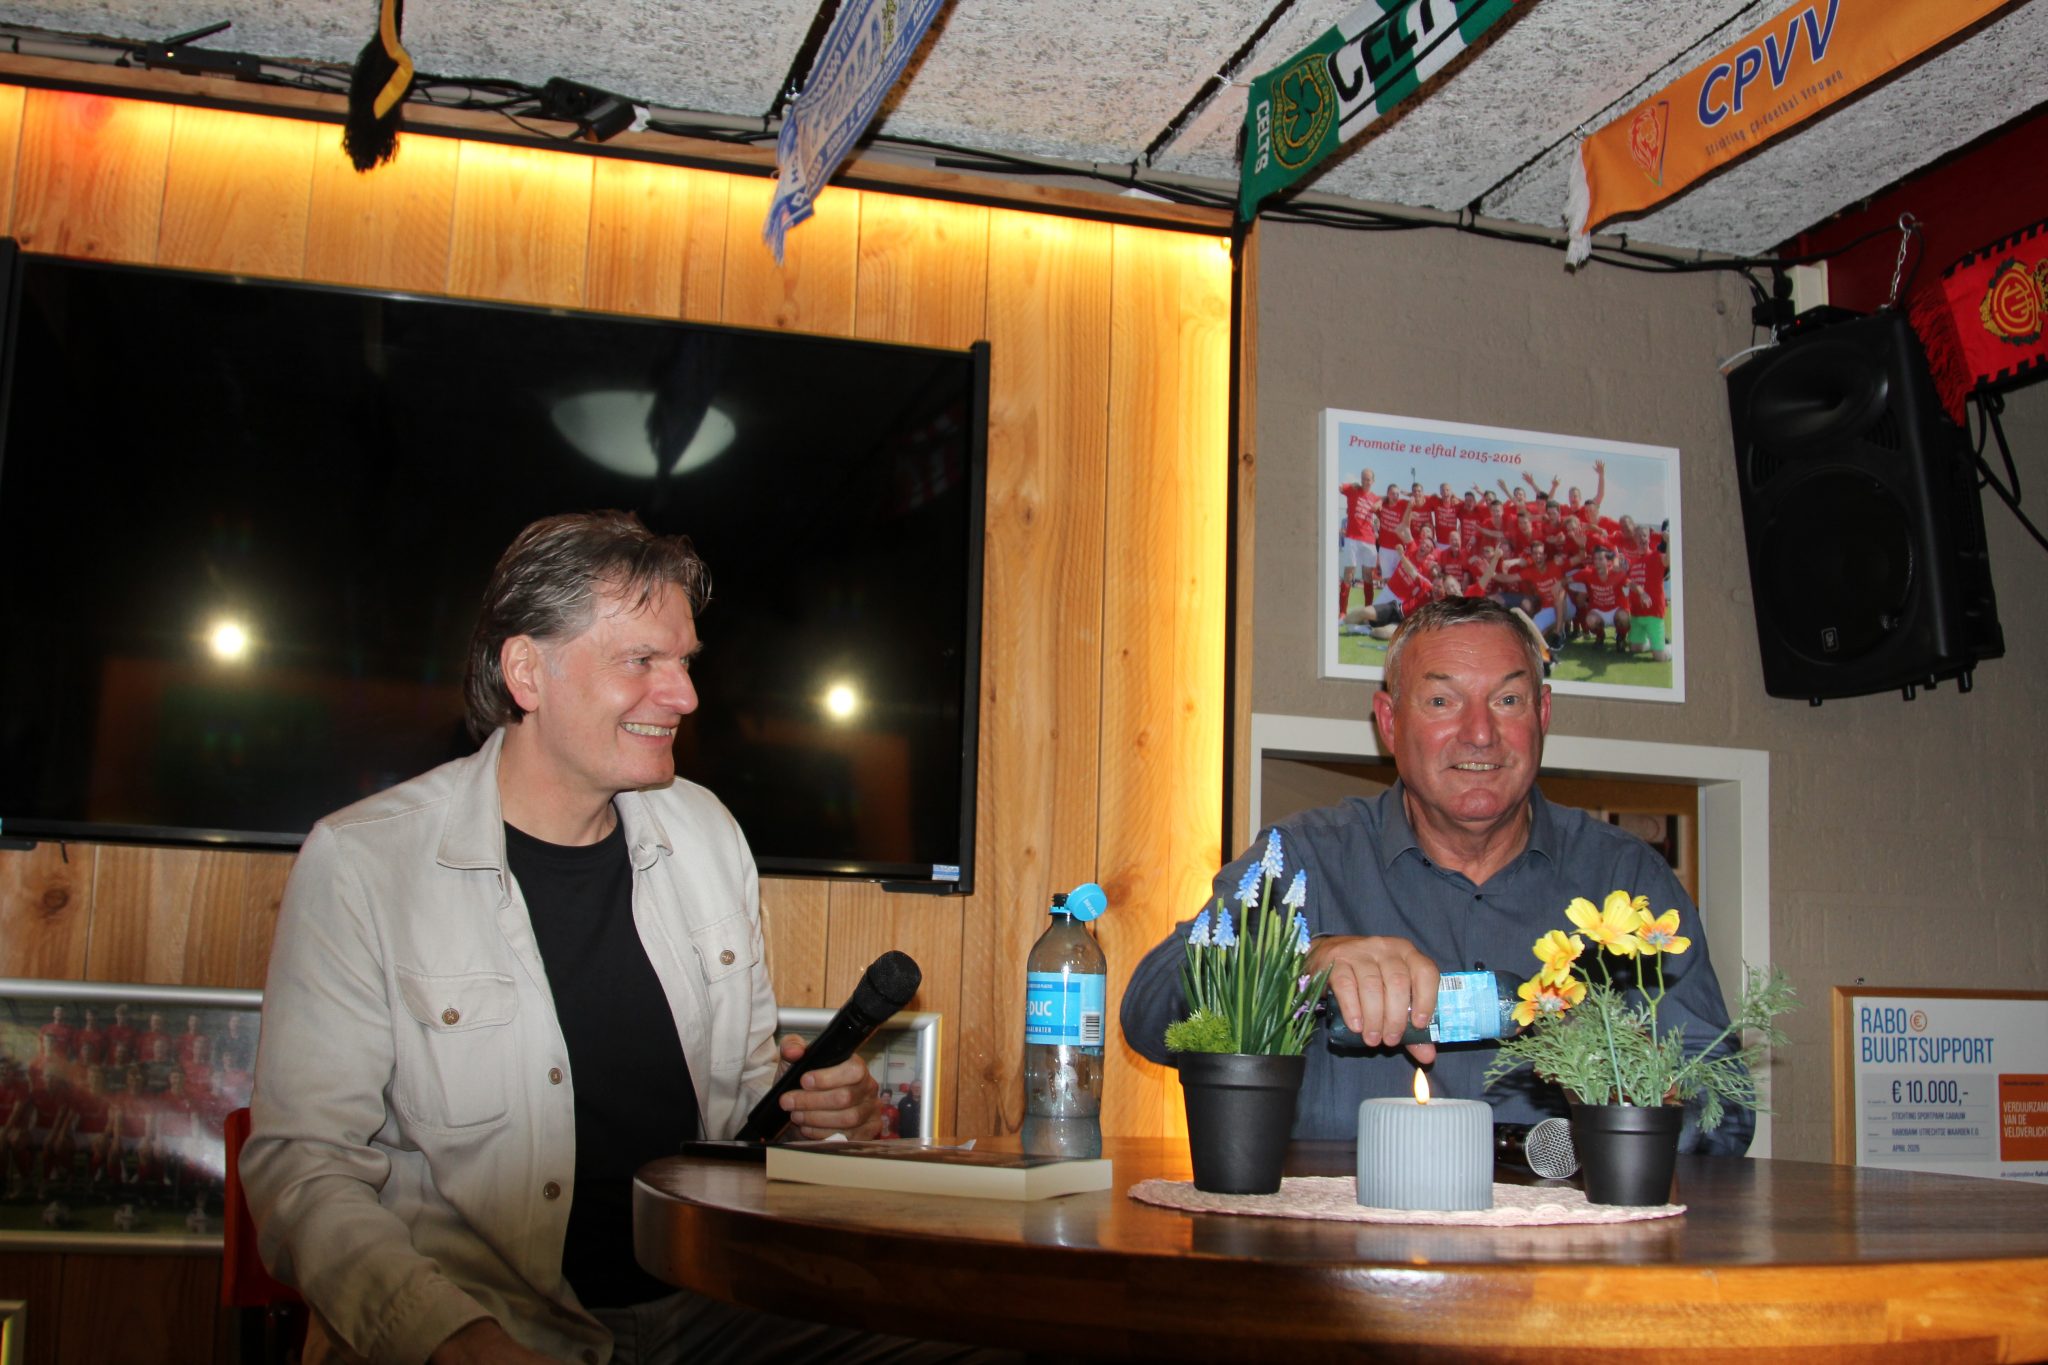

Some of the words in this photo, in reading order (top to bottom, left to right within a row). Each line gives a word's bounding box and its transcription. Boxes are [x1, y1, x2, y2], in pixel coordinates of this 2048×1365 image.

[1697, 0, 1839, 128] CPVV
[1801, 70, 1843, 100] Vrouwen
[1254, 99, 1270, 175] CELTS
[1349, 435, 1406, 452] Promotie
[1410, 444, 1422, 454] 1e
[1424, 444, 1456, 458] elftal
[1459, 449, 1522, 464] 2015-2016
[1861, 1007, 1907, 1034] RABO
[1862, 1036, 1994, 1064] BUURTSUPPORT
[1892, 1080, 1902, 1104] €
[1906, 1080, 1969, 1106] 10.000,-
[2003, 1113, 2017, 1125] VAN
[2018, 1114, 2028, 1125] DE
